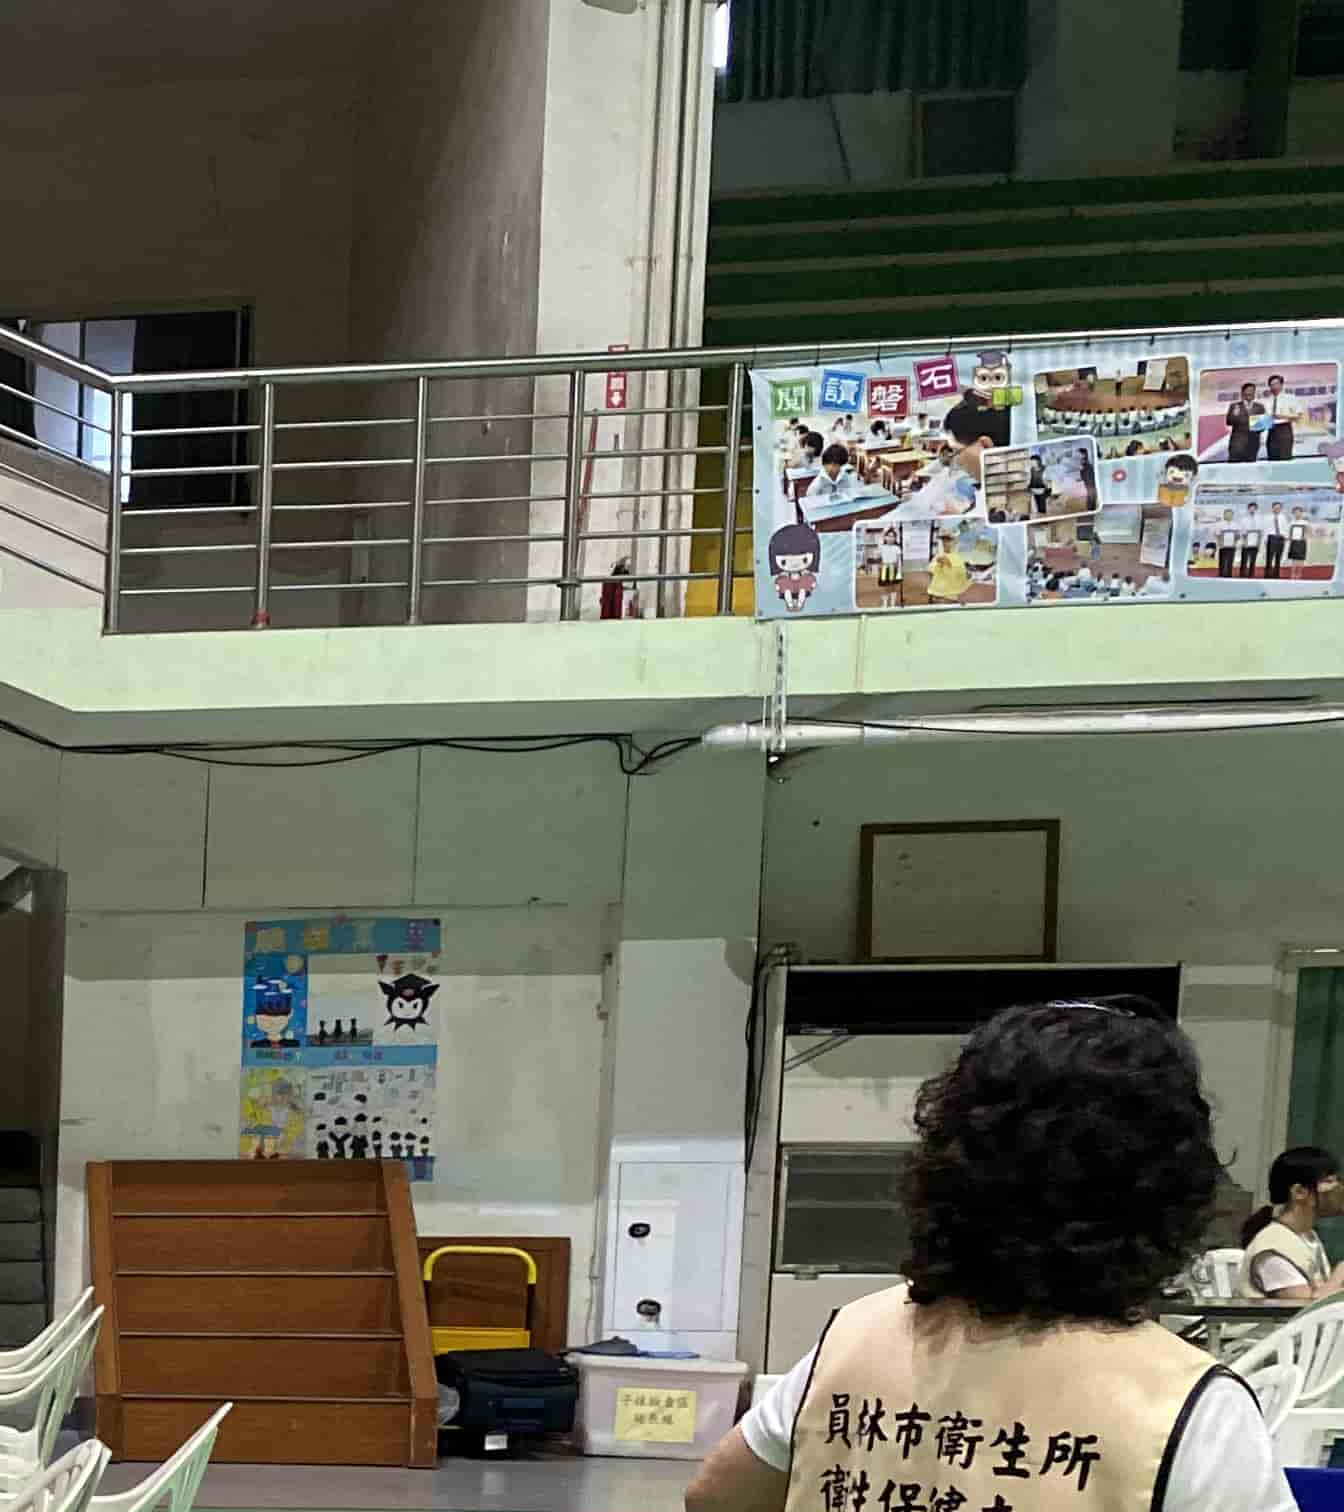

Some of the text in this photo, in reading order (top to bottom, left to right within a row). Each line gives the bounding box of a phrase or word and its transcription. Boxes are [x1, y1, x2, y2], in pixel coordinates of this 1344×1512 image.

[776, 363, 954, 414] 閱讀磐石
[823, 1393, 1101, 1492] 員林市衛生所
